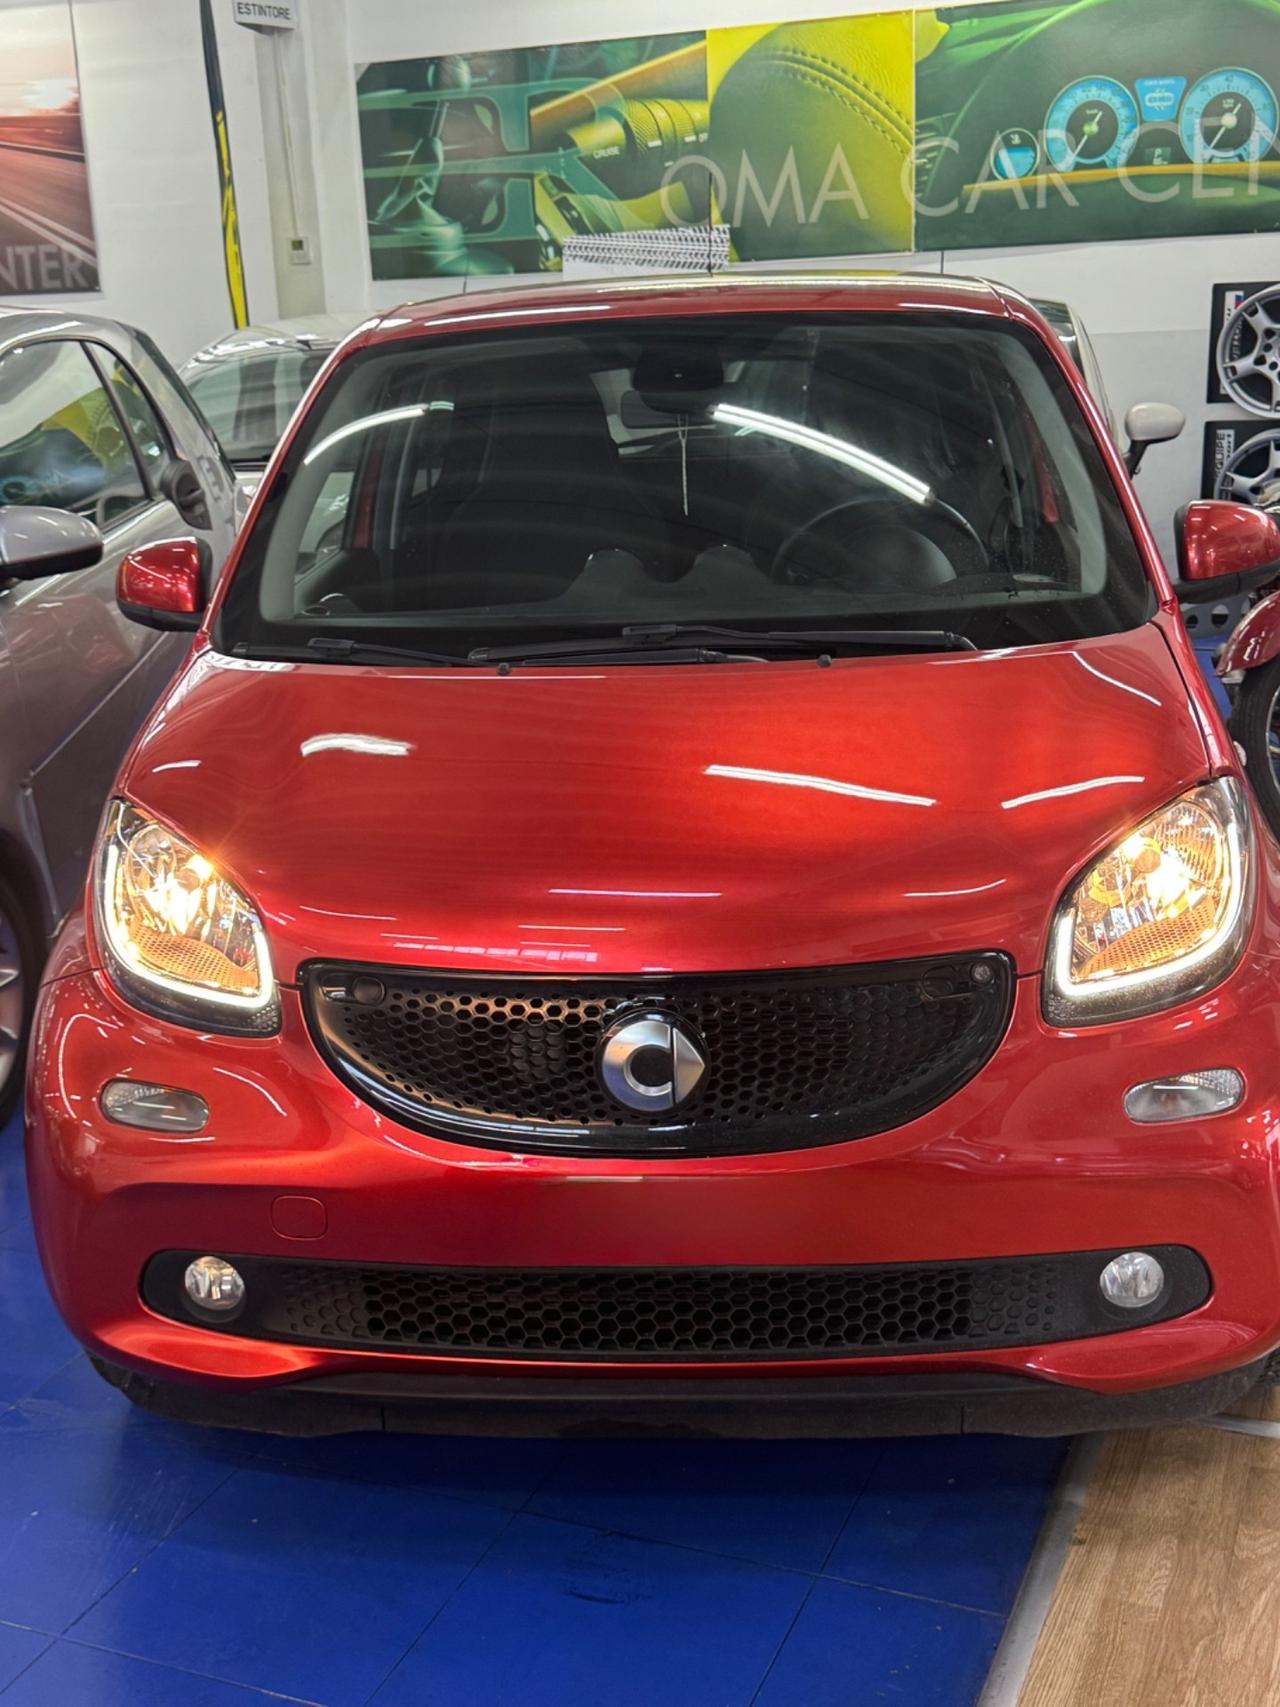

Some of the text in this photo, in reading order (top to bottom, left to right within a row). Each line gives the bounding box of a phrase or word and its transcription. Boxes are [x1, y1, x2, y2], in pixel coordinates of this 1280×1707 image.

[237, 2, 291, 20] ESTINTORE
[593, 145, 620, 160] CRUISE
[660, 143, 869, 228] OMA
[902, 130, 1080, 217] CAR
